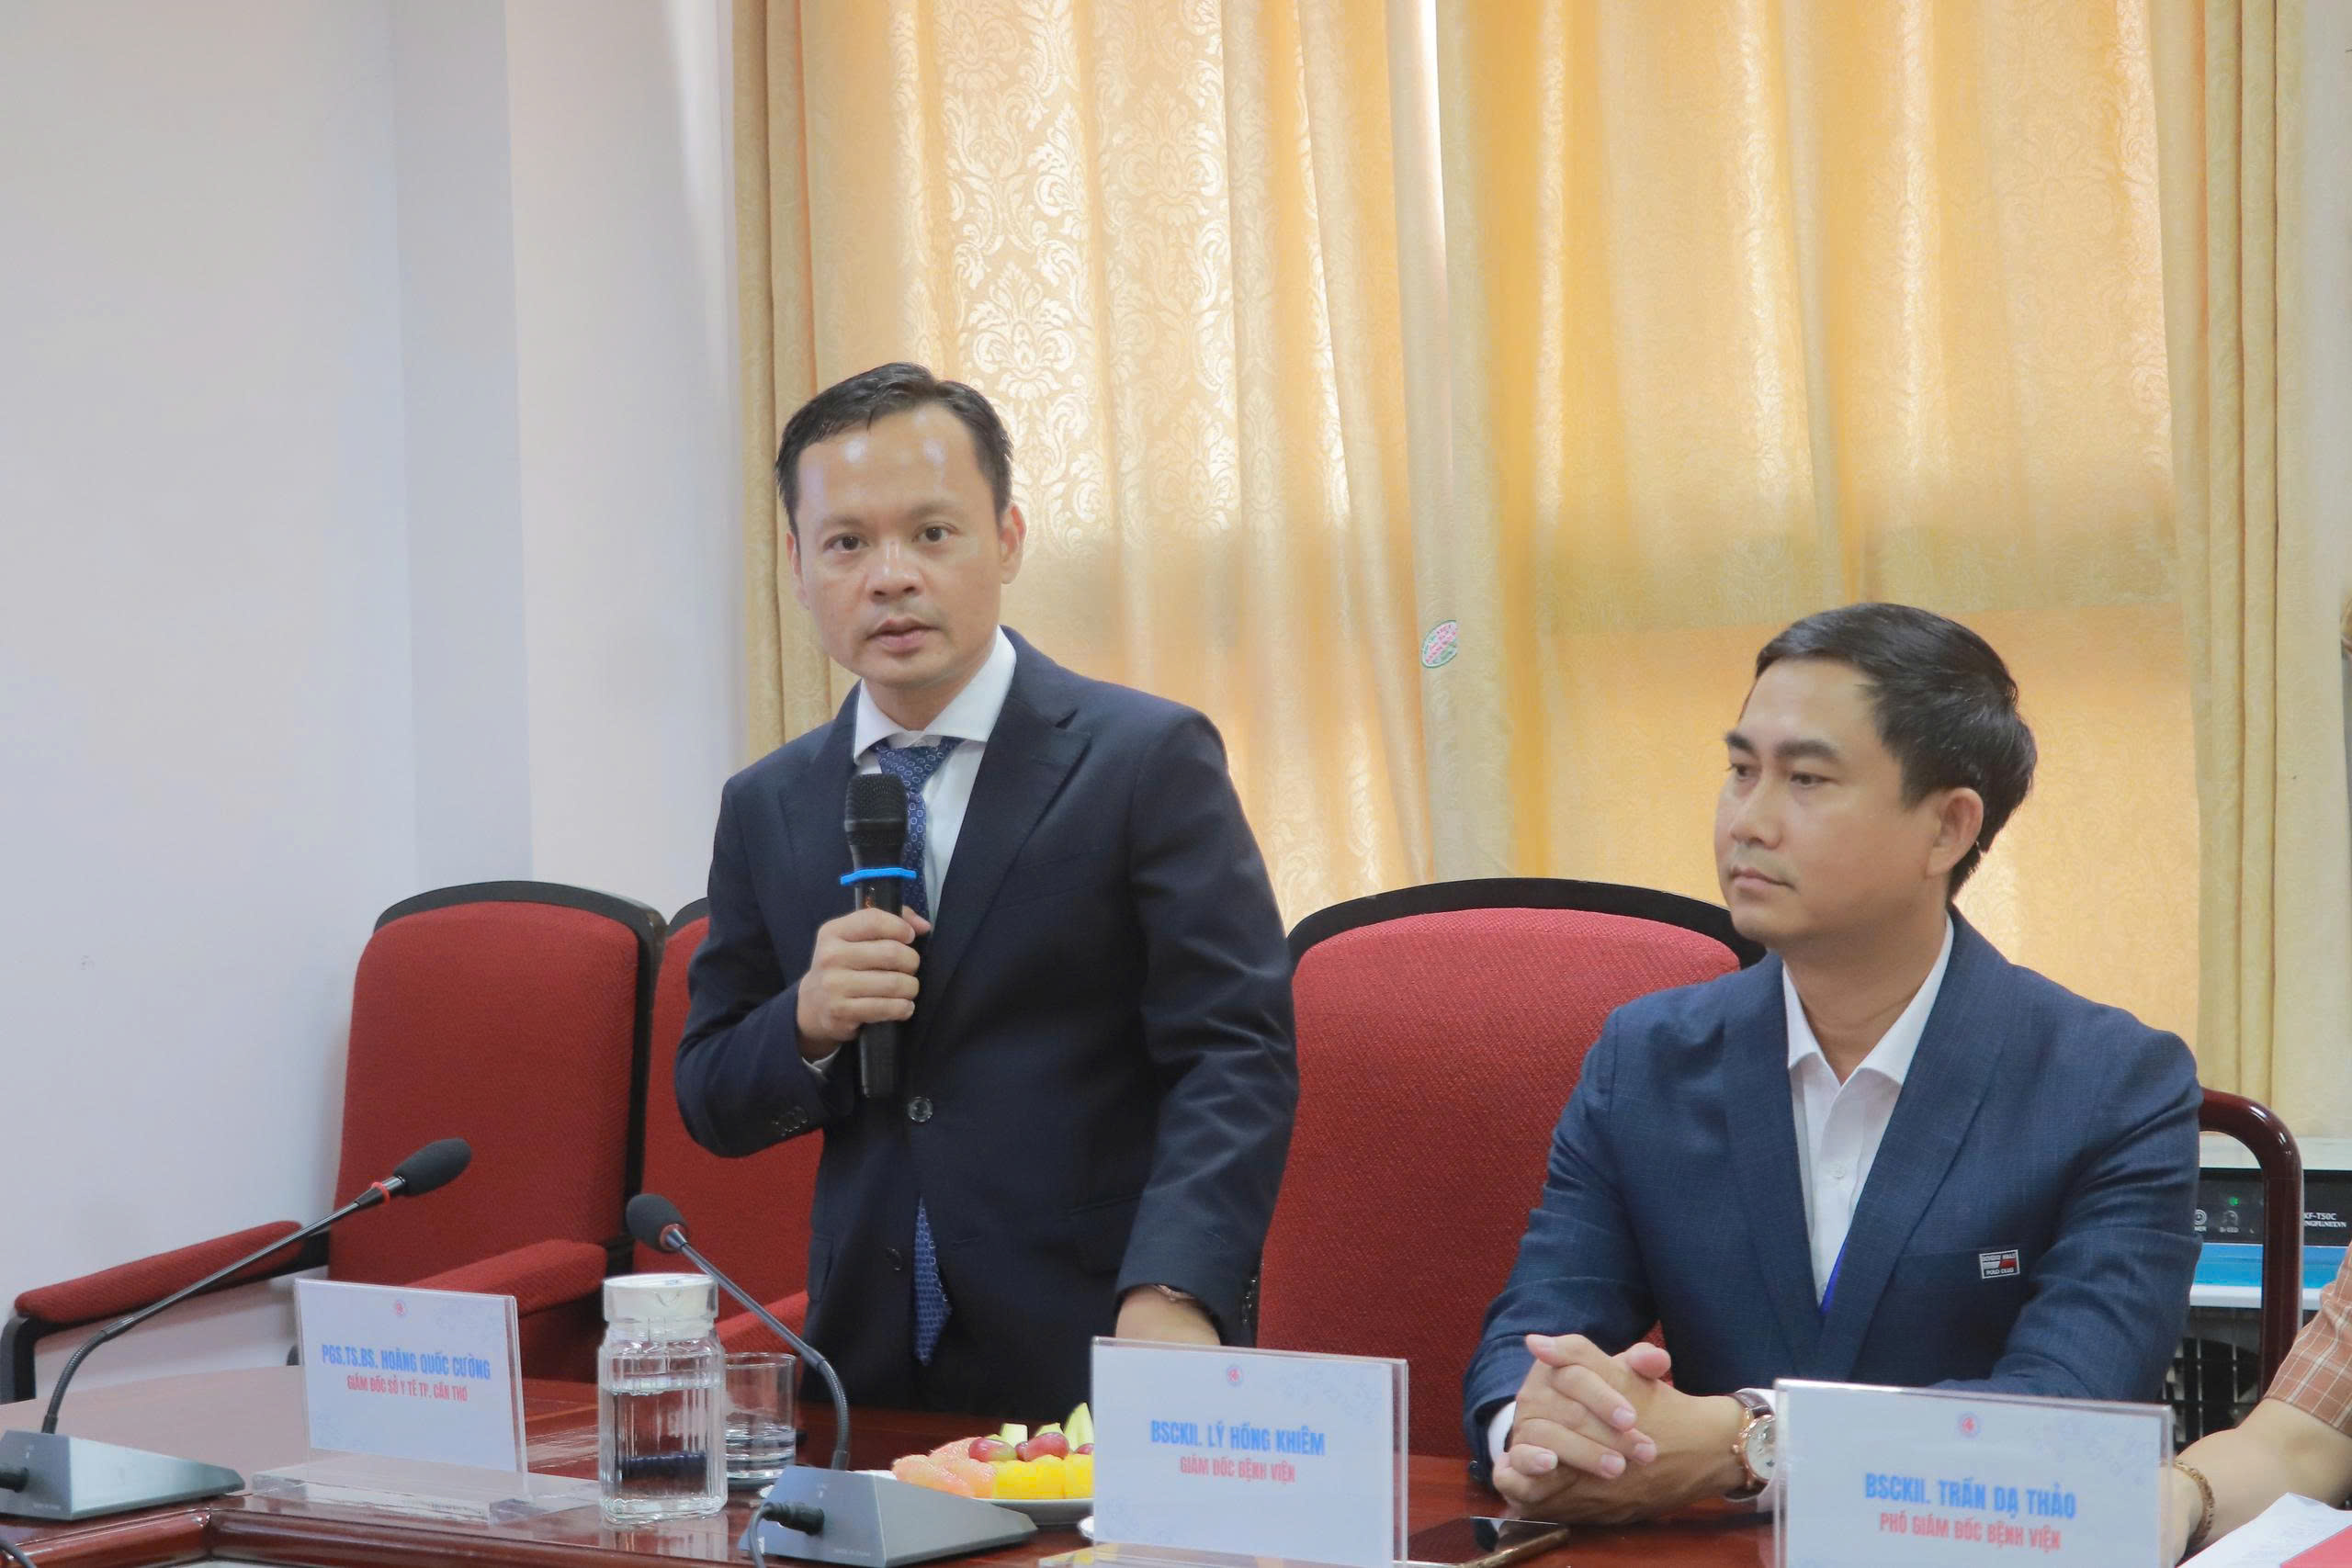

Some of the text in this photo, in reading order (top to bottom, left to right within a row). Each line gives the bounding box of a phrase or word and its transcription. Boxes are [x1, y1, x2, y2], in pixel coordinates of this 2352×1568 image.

[322, 1344, 492, 1380] PGS.TS.BS. HOÀNG QUỐC CƯỜNG
[346, 1372, 368, 1391] GIÁM
[401, 1381, 405, 1395] Y
[419, 1382, 432, 1398] TP.
[1151, 1420, 1203, 1446] BSCKII.
[1207, 1421, 1225, 1448] LÝ
[1276, 1426, 1326, 1456] KHIÊM
[1238, 1458, 1266, 1483] BỆNH
[1271, 1461, 1295, 1484] VIỆN
[1865, 1472, 1930, 1504] BSCKII.
[1994, 1485, 2018, 1519] DẠ
[2026, 1482, 2076, 1519] THẢO
[1880, 1510, 2061, 1554] PHÓ GIÁM ĐỐC BỆNH VIỆN
